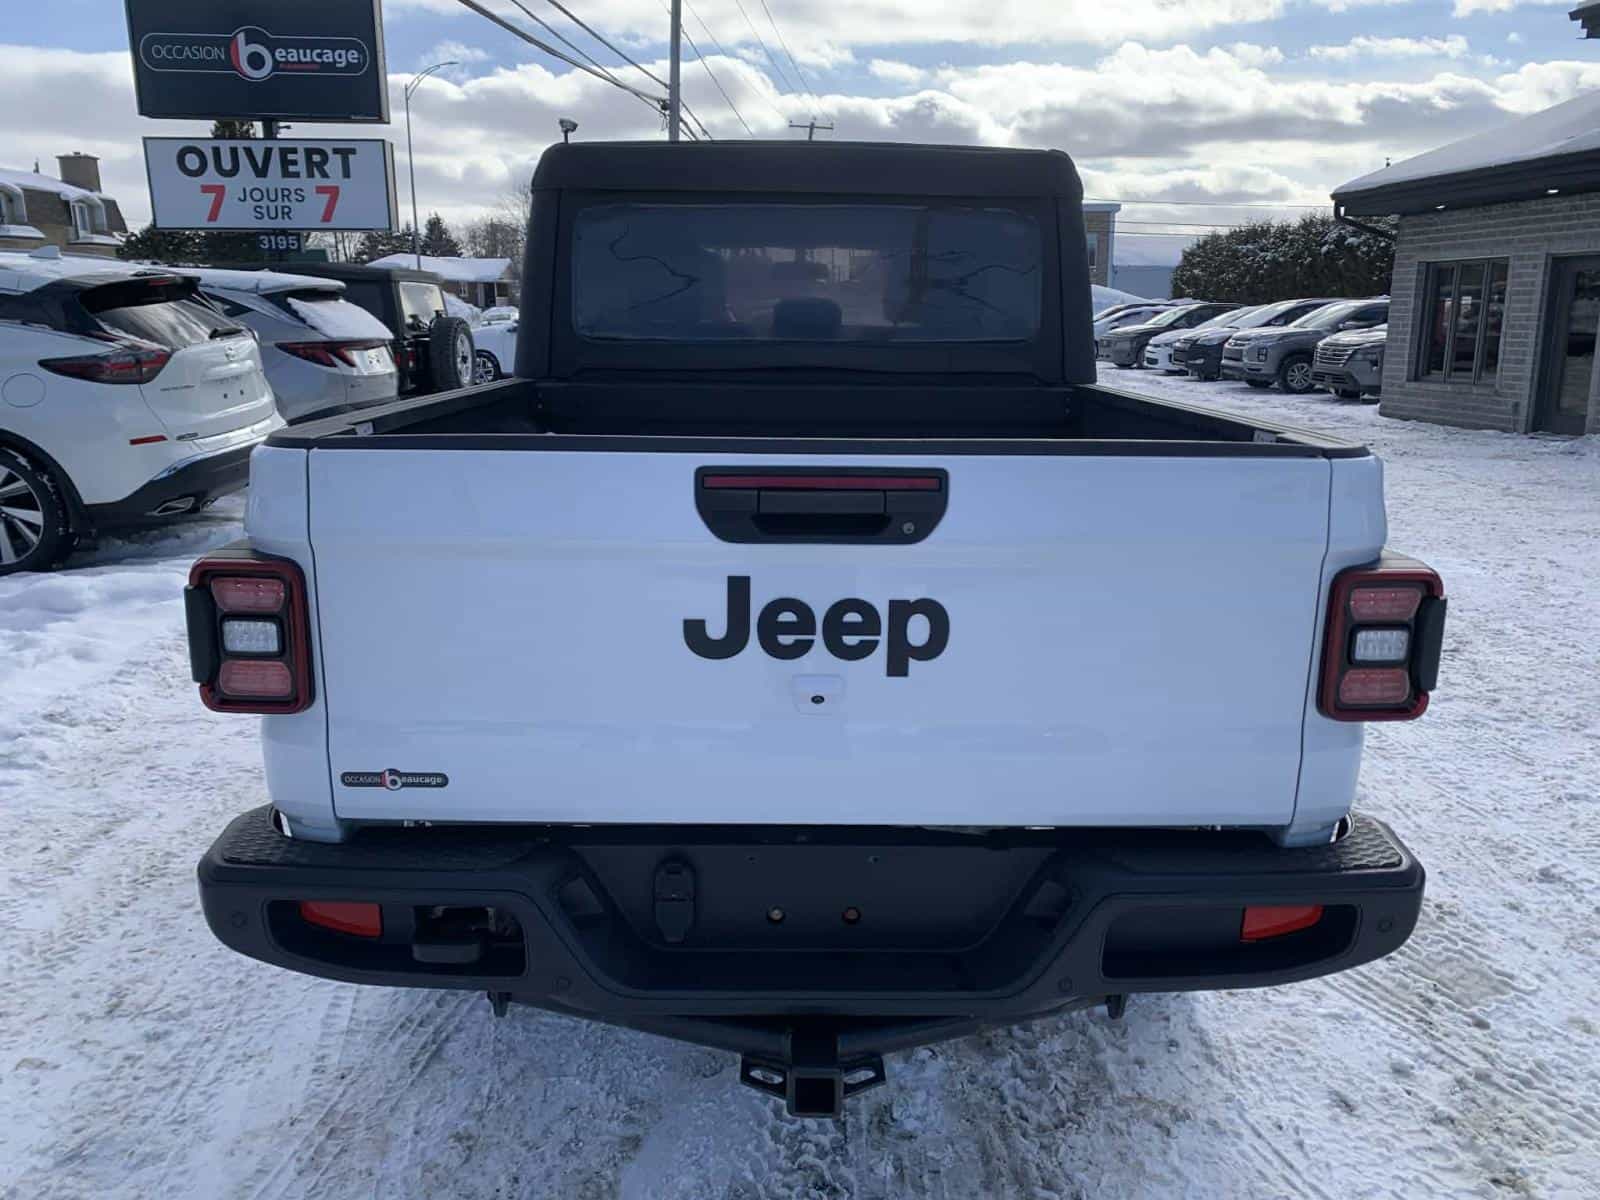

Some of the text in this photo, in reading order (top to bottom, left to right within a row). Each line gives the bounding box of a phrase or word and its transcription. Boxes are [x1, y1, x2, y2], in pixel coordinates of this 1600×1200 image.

[151, 45, 225, 61] OCCASION
[176, 145, 357, 179] OUVERT
[200, 184, 341, 223] 7 JOURS SUR 7
[258, 235, 298, 250] 3195
[682, 575, 951, 677] Jeep
[344, 775, 380, 785] OCCASION
